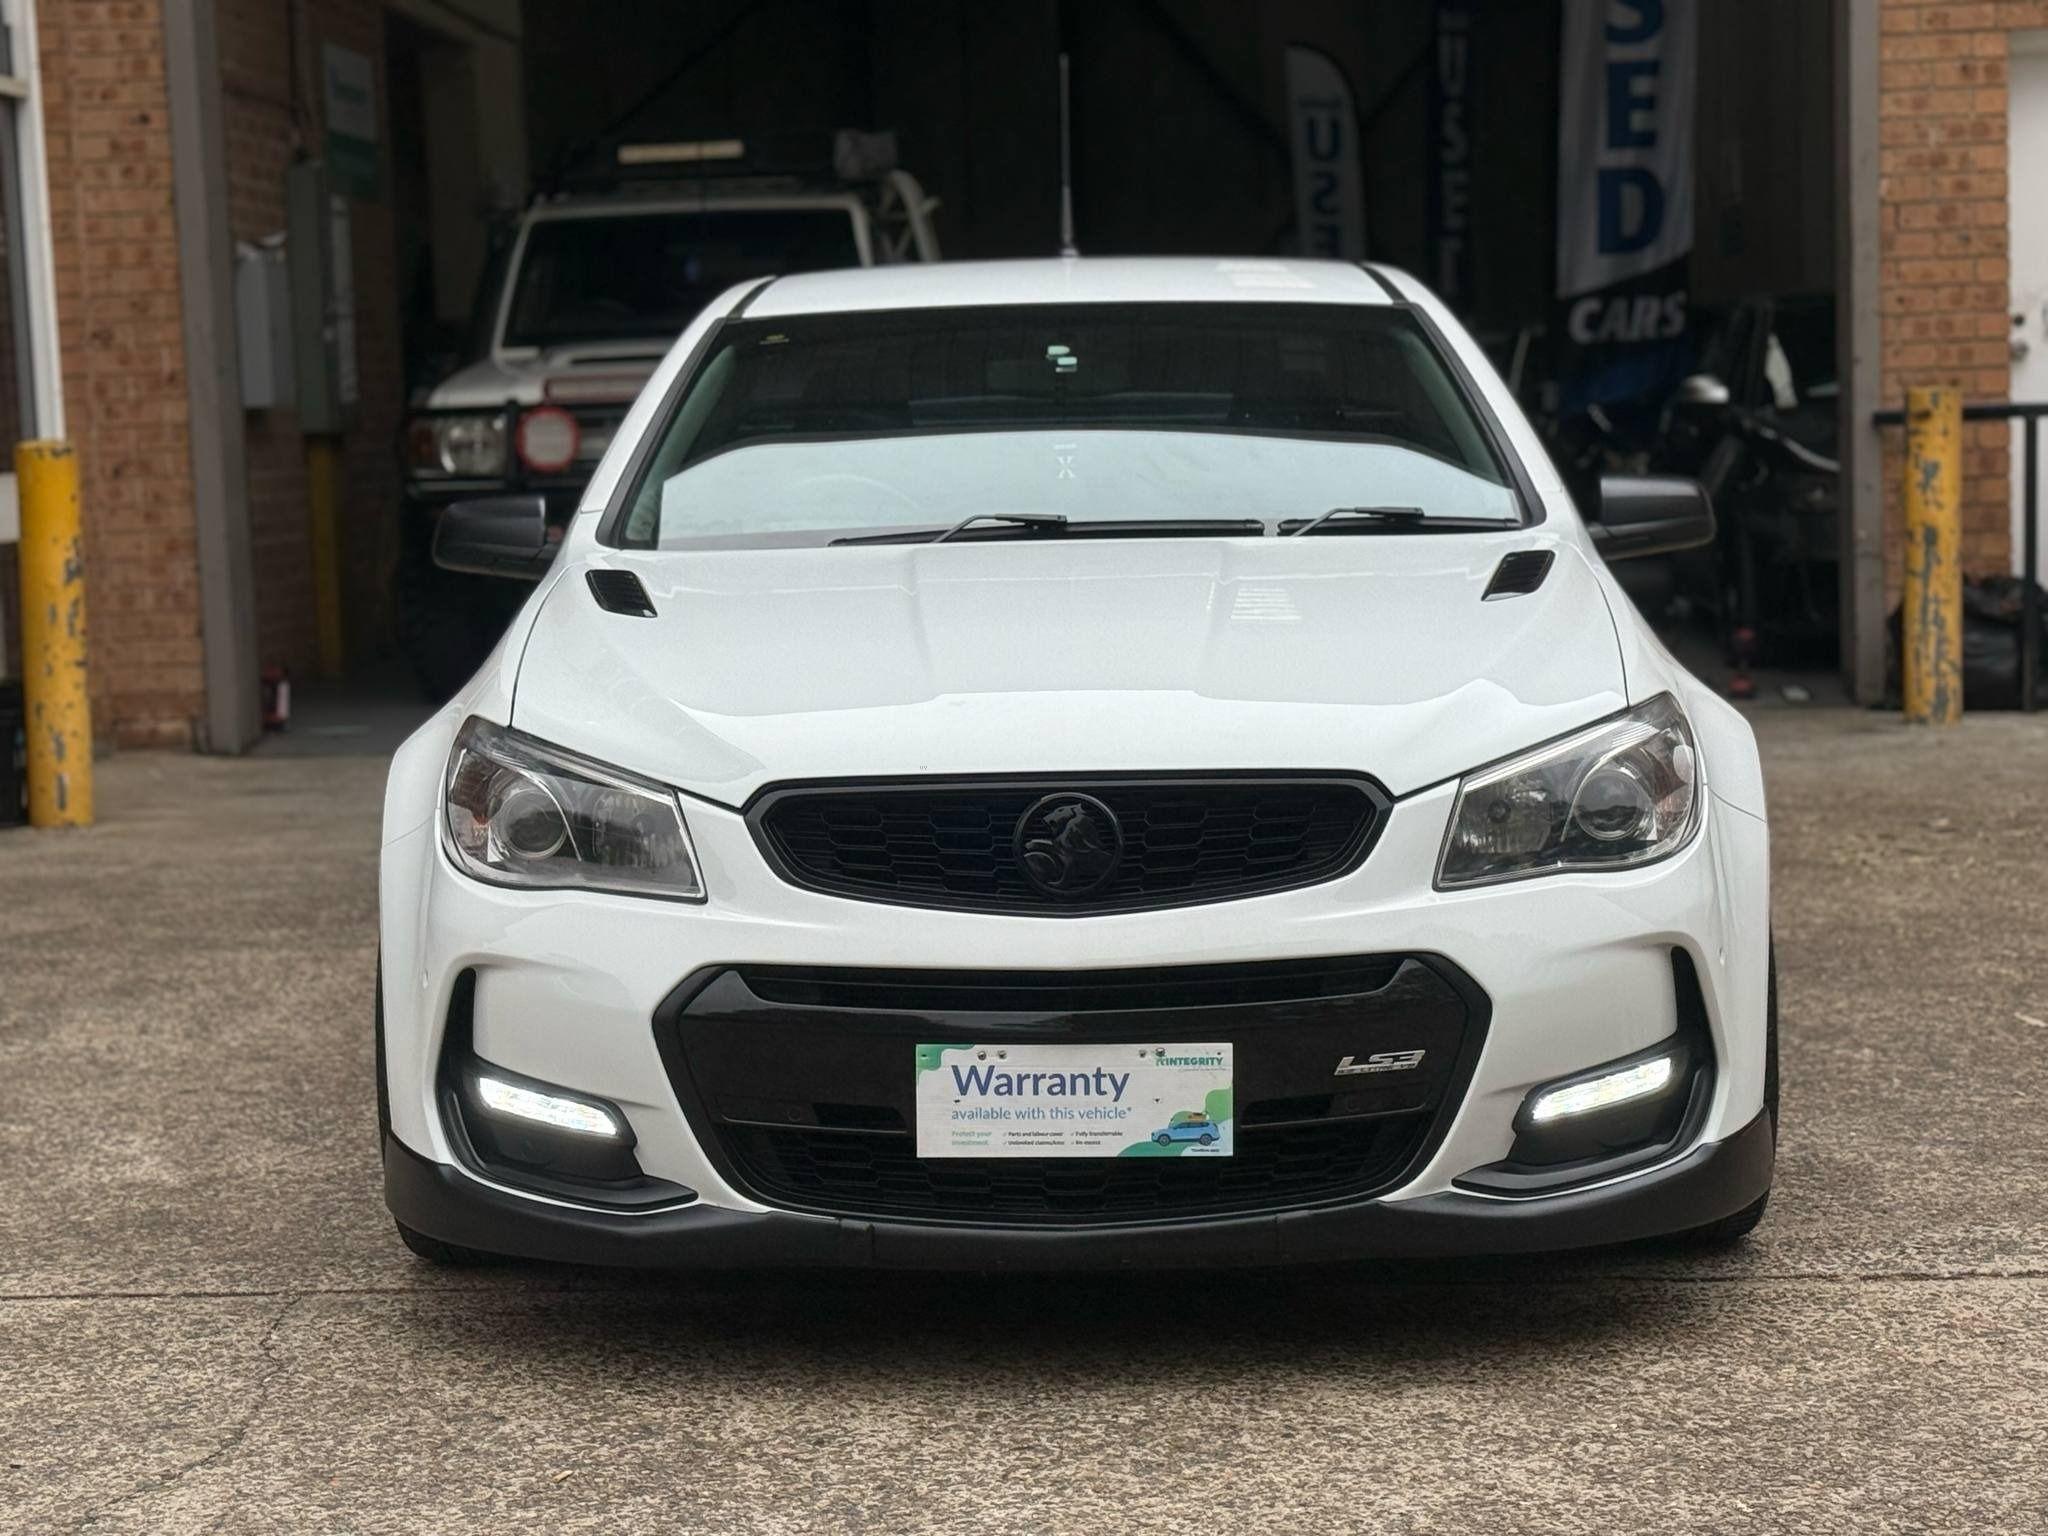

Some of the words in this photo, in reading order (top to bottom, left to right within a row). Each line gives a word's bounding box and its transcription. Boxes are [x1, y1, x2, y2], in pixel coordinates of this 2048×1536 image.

[1568, 291, 1686, 344] CARS
[1166, 1056, 1223, 1066] INTEGRITY
[1334, 1049, 1425, 1076] LS3
[951, 1065, 1130, 1102] Warranty
[952, 1107, 1011, 1120] available
[1015, 1107, 1045, 1120] with
[1050, 1107, 1075, 1120] this
